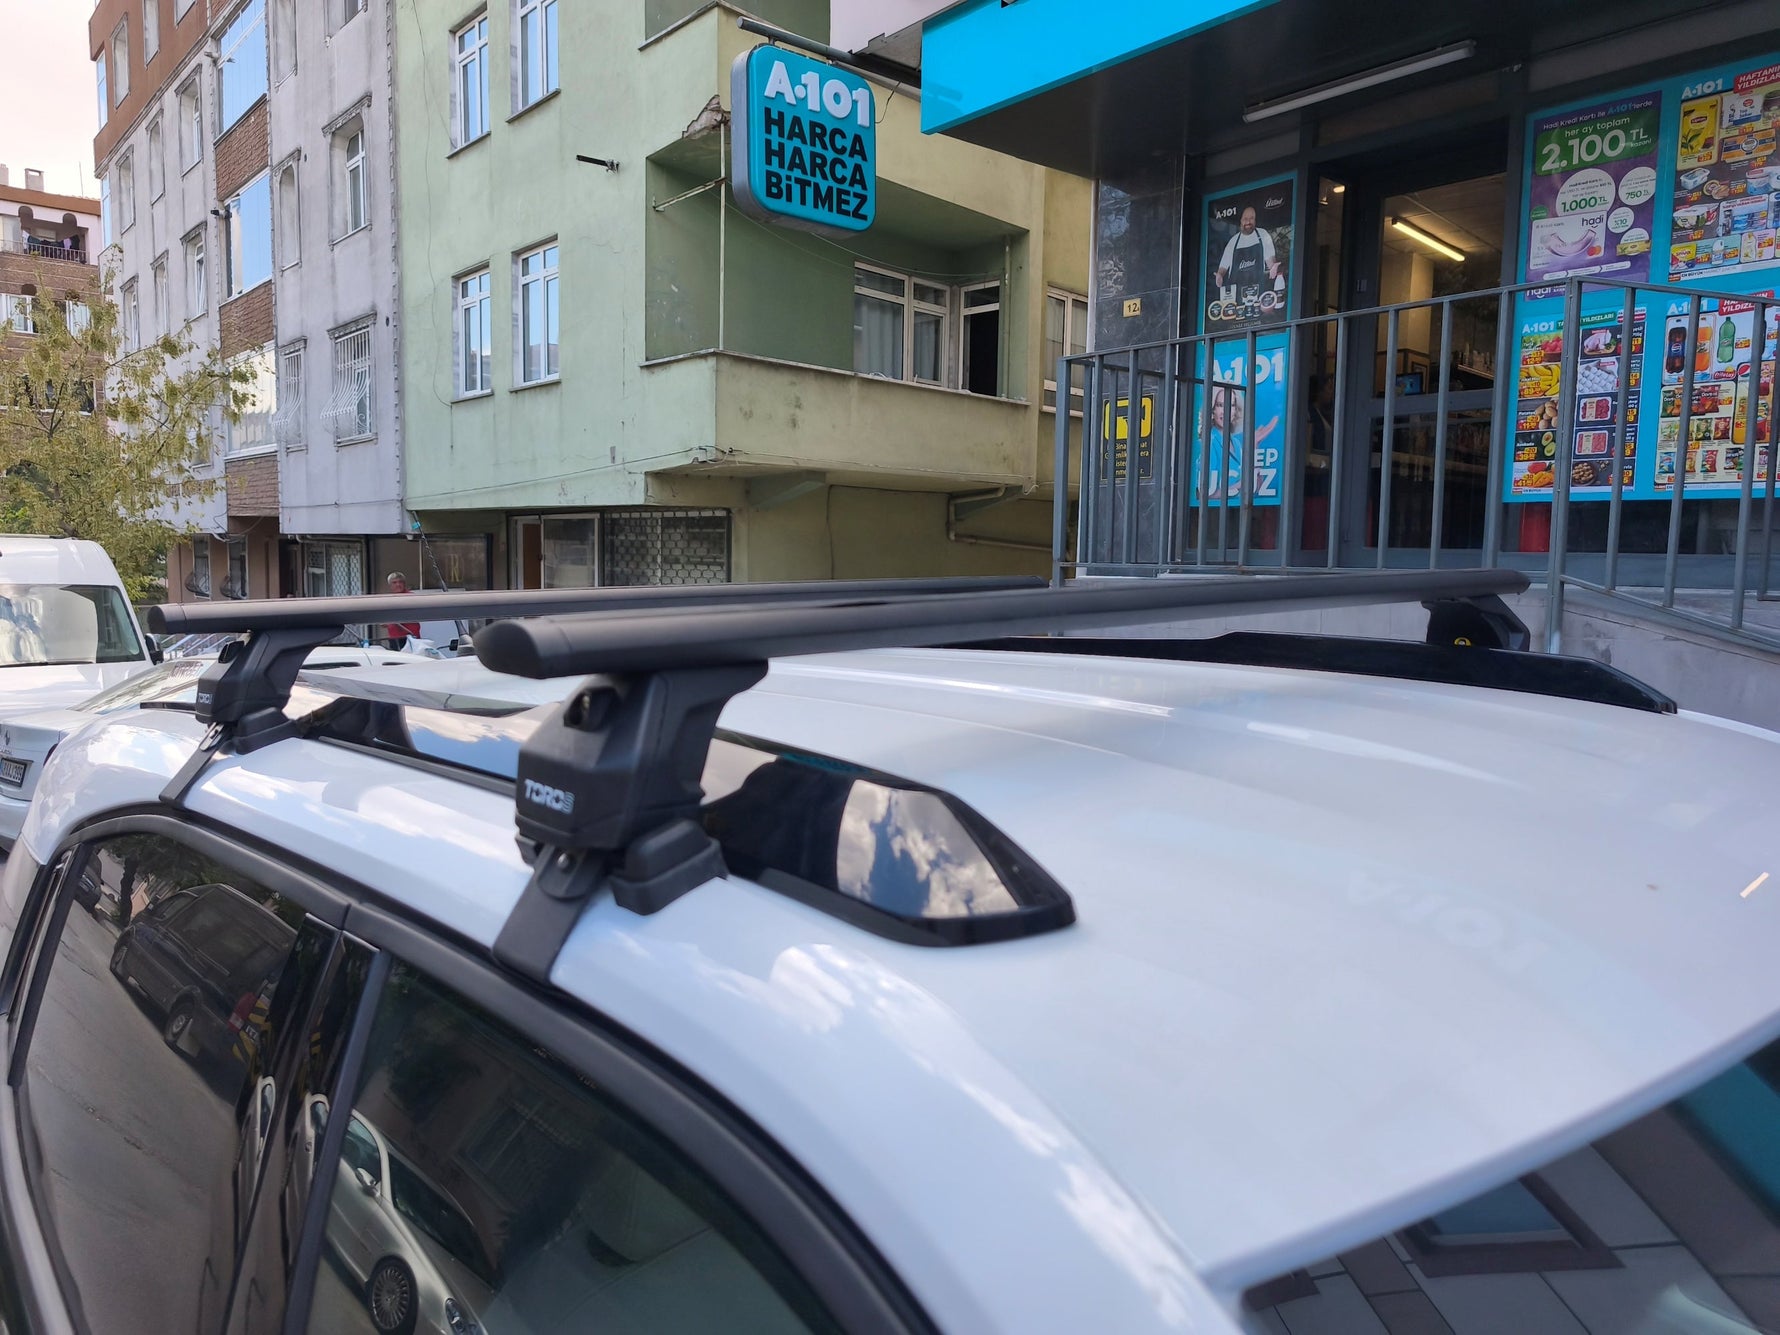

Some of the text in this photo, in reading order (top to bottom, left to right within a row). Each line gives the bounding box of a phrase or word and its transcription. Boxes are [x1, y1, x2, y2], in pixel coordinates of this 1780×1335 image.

[764, 106, 868, 162] HARCA
[1565, 117, 1630, 138] her ay toplam
[1541, 128, 1649, 172] 2.100 TL
[764, 138, 868, 191] HARCA
[1561, 195, 1598, 213] 1.000
[1625, 190, 1642, 200] 750
[1581, 214, 1604, 228] hadi
